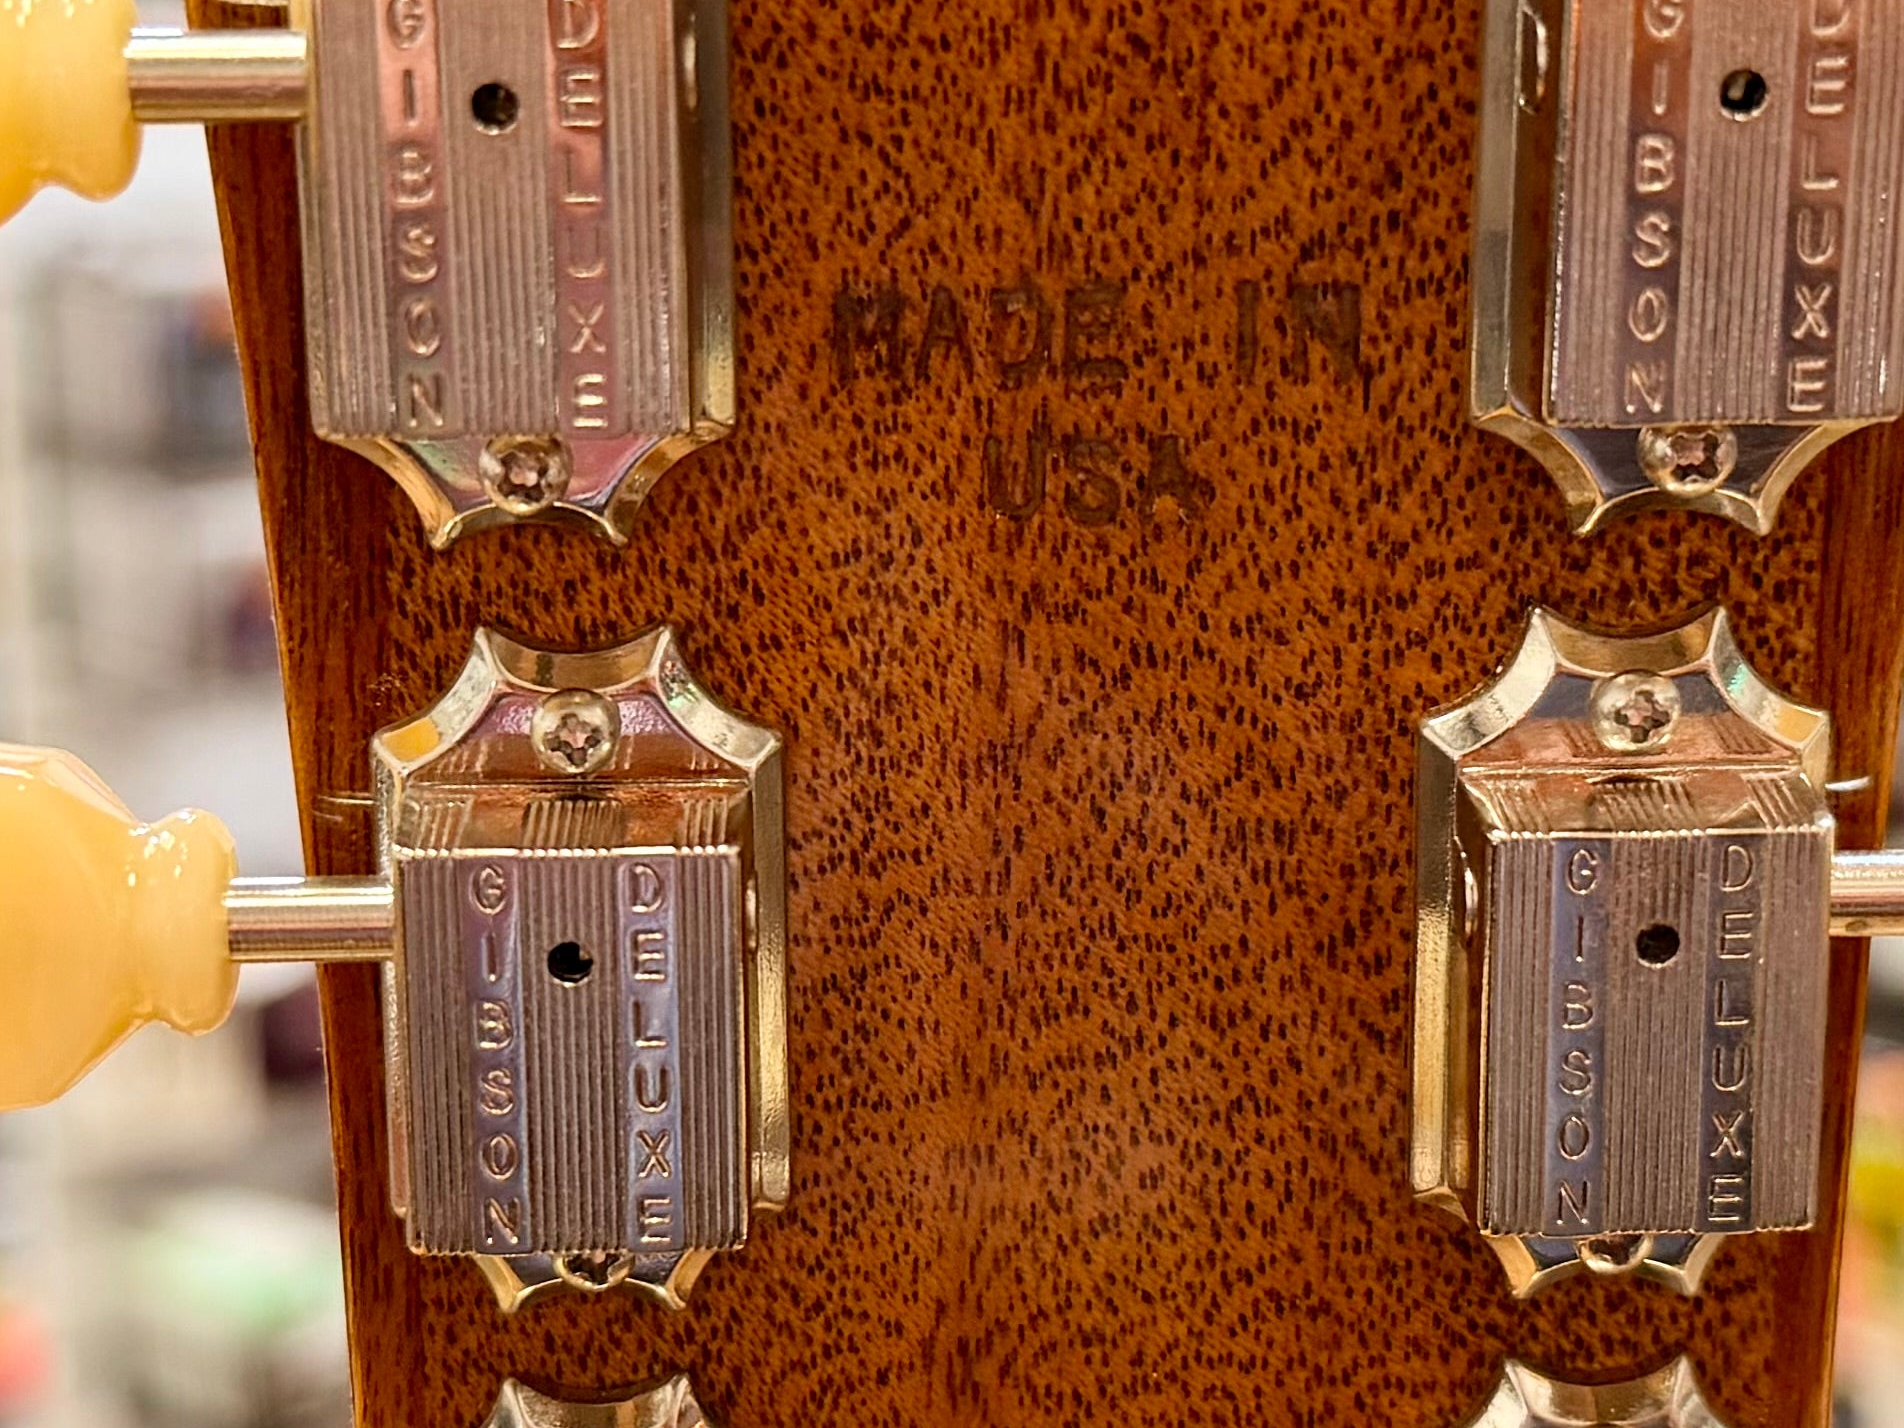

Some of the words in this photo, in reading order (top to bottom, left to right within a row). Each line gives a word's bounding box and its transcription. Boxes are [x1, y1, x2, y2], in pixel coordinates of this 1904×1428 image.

[830, 280, 1126, 390] MADE
[1234, 278, 1364, 386] IN
[982, 427, 1216, 526] USA
[471, 865, 518, 1245] GIBSON
[630, 864, 672, 1243] DELUXE
[1555, 848, 1599, 1226] GIBSON
[1707, 844, 1755, 1223] DELUXE
